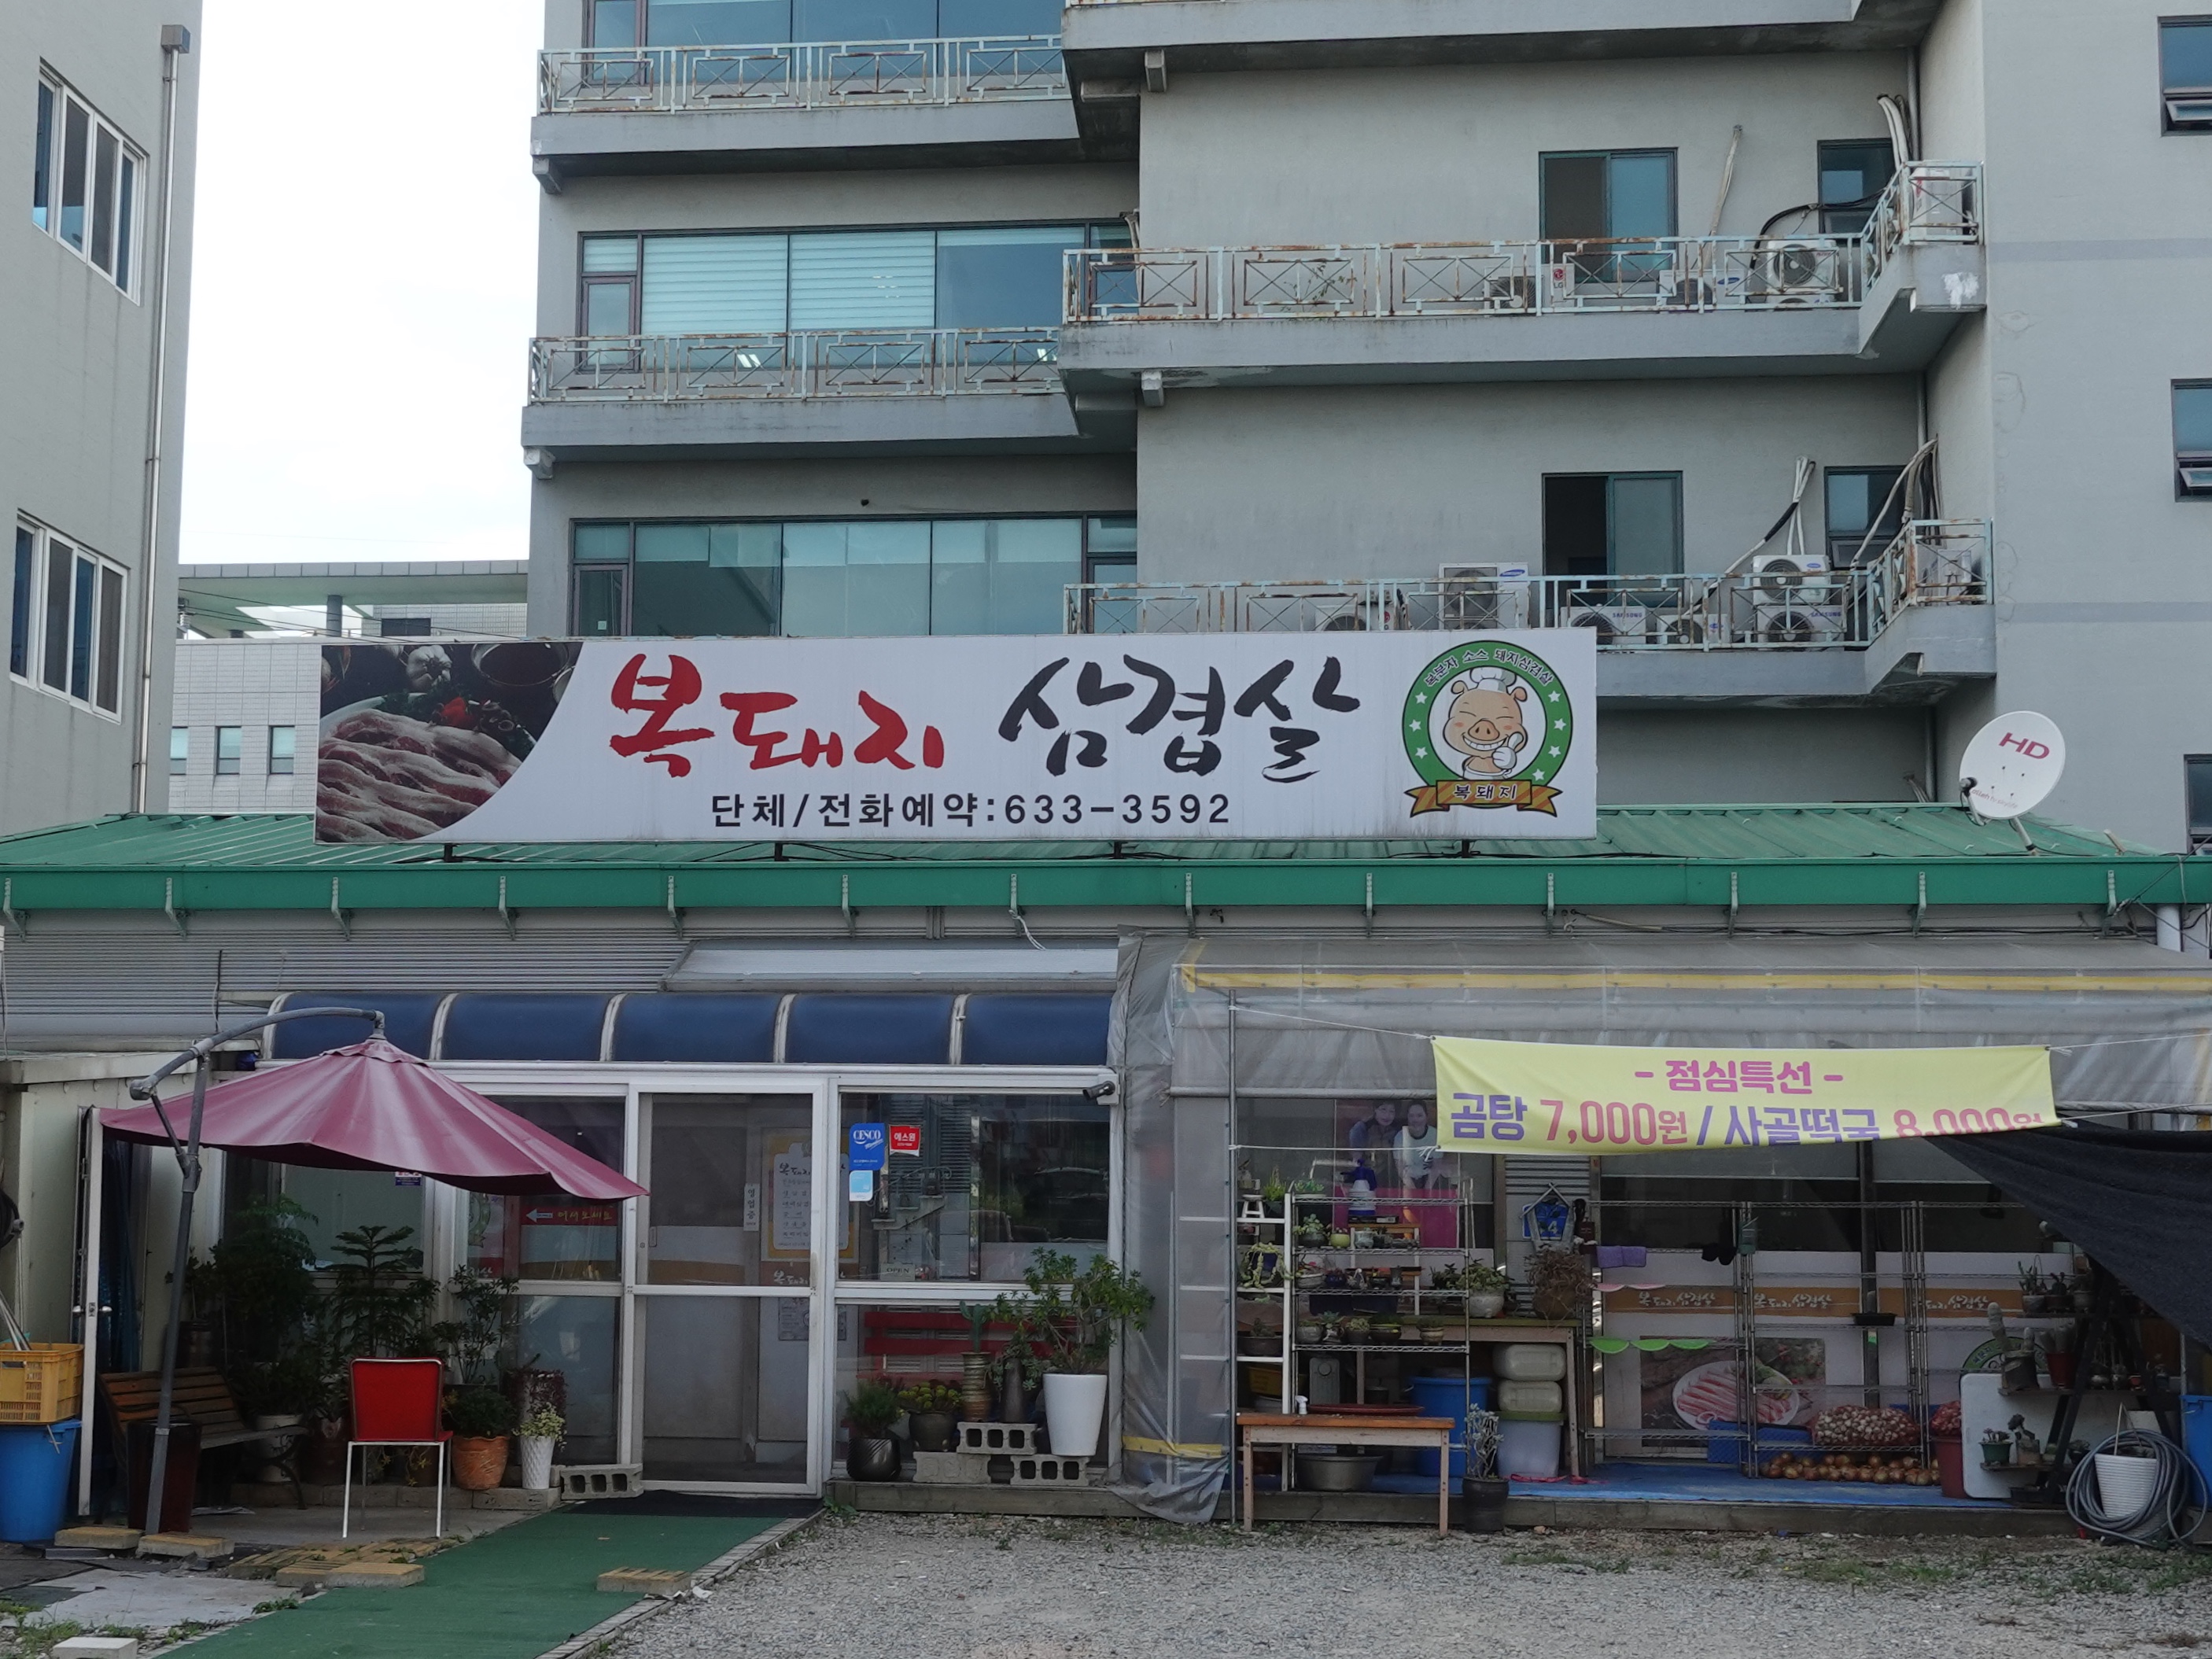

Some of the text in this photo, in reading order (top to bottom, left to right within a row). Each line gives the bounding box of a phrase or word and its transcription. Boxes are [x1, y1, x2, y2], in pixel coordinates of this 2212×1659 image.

[1462, 648, 1490, 663] 소스
[1494, 647, 1555, 686] 돼지삼겹살
[610, 653, 1361, 783] 복돼지 삼겹살
[1998, 732, 2050, 760] HD
[1454, 783, 1518, 801] 복돼지
[1451, 1092, 1528, 1141] 곰탕
[1539, 1098, 1688, 1145] 7,000원
[1724, 1105, 1881, 1146] 사골떡국
[853, 1129, 882, 1141] CESCO
[894, 1132, 916, 1142] 에스원
[747, 1188, 756, 1220] 영업중
[1676, 1291, 1716, 1307] 삼겹살
[1791, 1292, 1833, 1310] 삼겹살
